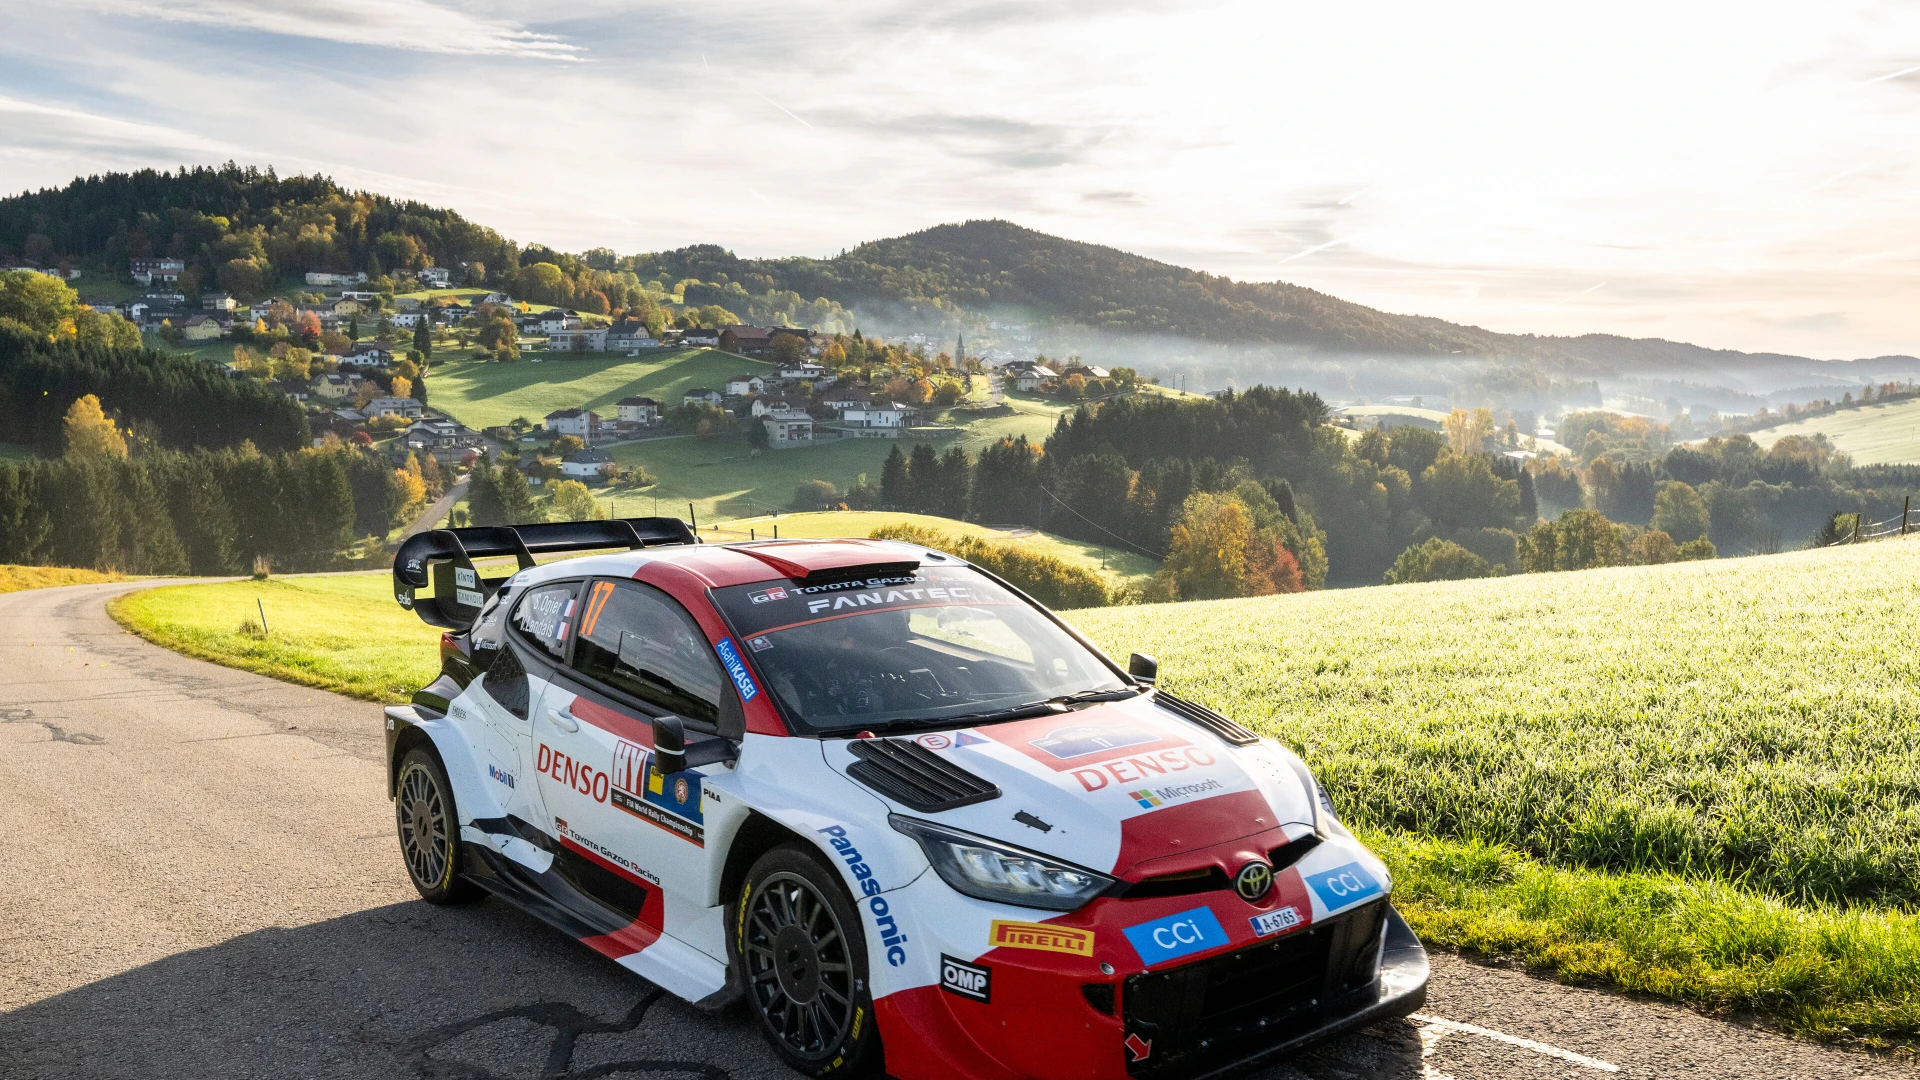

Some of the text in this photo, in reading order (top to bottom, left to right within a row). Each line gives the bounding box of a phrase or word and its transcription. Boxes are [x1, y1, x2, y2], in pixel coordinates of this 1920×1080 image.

[751, 590, 787, 604] GR
[790, 580, 864, 595] TOYOTA
[866, 576, 926, 585] GAZOO
[533, 594, 562, 615] S.Ogier
[580, 581, 616, 636] 17
[807, 587, 972, 614] FANATEC
[924, 737, 943, 747] E
[488, 764, 508, 786] Mobil
[537, 743, 609, 804] DENSO
[1069, 747, 1216, 792] DENSO
[703, 788, 721, 803] PIAA
[1155, 778, 1223, 801] Microsoft
[634, 802, 648, 815] World
[569, 829, 660, 885] TOYOTA GAZOO Racing
[817, 824, 908, 968] Panasonic
[1262, 910, 1295, 931] A-6765
[996, 924, 1087, 951] PIRELLI
[943, 965, 987, 992] OMP
